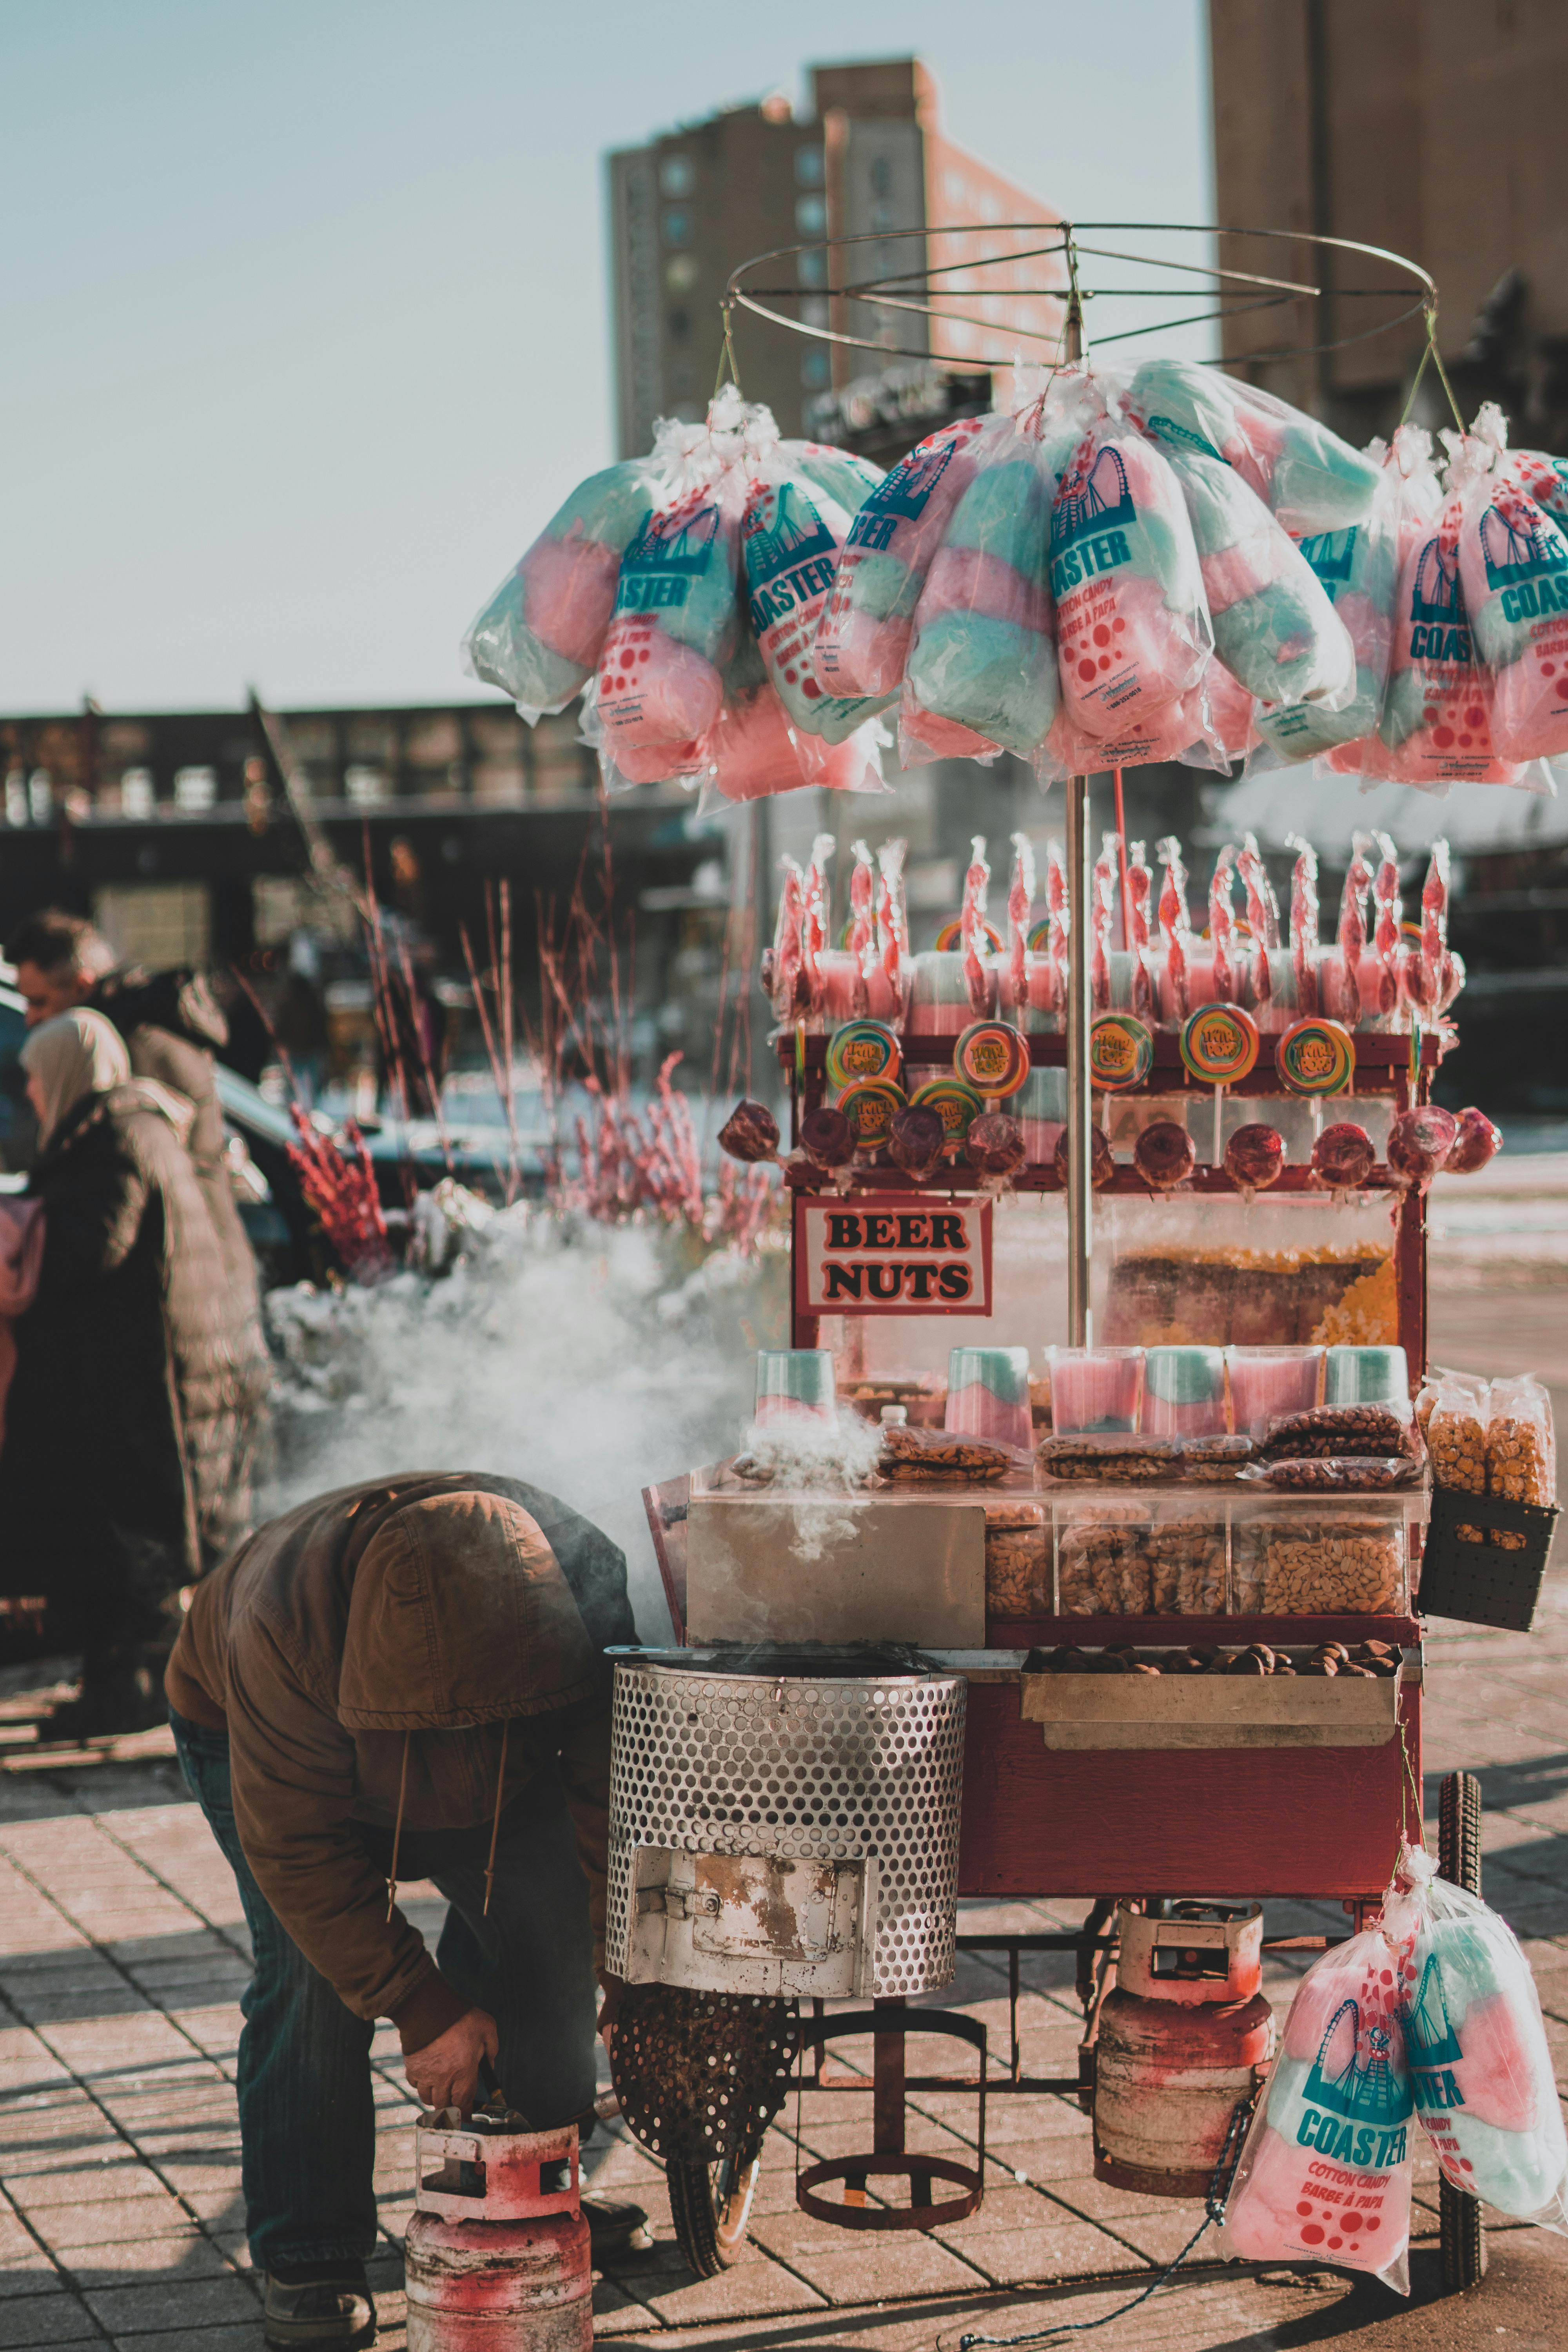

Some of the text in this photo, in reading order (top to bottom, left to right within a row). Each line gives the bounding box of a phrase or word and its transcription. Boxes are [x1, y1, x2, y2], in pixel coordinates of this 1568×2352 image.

[1049, 530, 1131, 600] ASTER
[1083, 577, 1113, 603] CANDY
[1093, 597, 1116, 621] PAPA
[1106, 687, 1142, 711] 1-888-252-0018
[1201, 1028, 1239, 1043] TWIRL
[1293, 1042, 1334, 1057] TWIRL
[1299, 1057, 1332, 1072] POPS
[934, 1100, 966, 1117] WIRL
[828, 1214, 967, 1249] BEER
[825, 1264, 969, 1299] NUTS
[1426, 2117, 1451, 2131] CANDY
[1296, 2109, 1407, 2168] COASTER
[1308, 2161, 1391, 2189] COTTON CANDY
[1300, 2181, 1344, 2204] BARBE
[1355, 2196, 1384, 2209] PAPA
